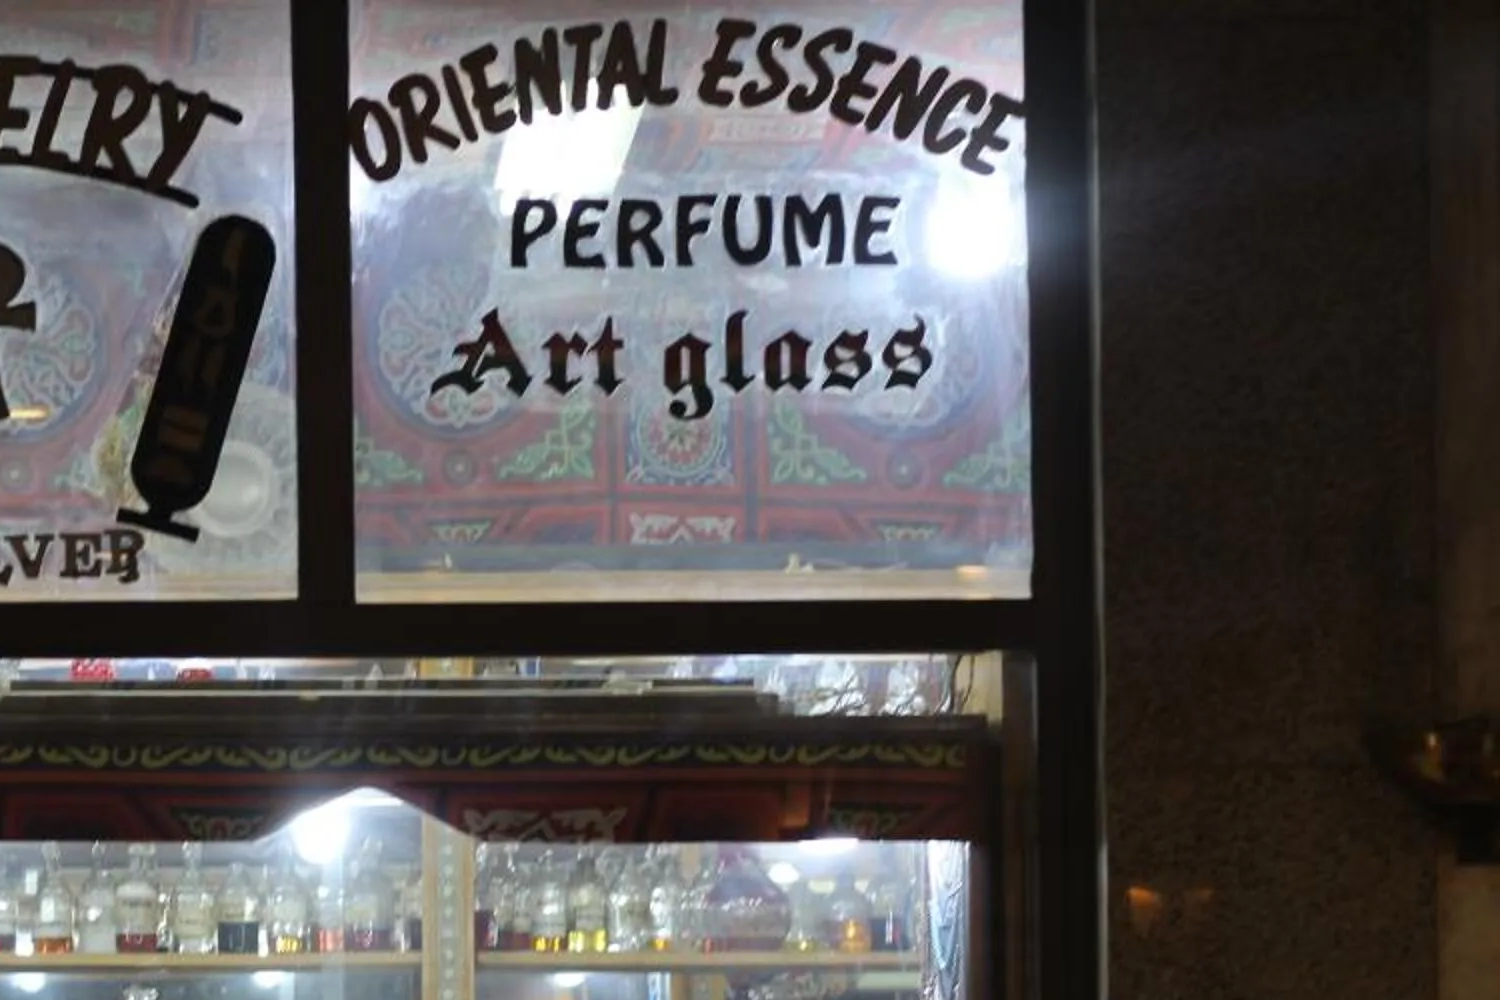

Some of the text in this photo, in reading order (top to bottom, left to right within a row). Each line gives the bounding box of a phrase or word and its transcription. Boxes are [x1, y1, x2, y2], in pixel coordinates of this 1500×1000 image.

[349, 19, 1026, 182] ORIENTAL ESSENCE
[509, 193, 901, 269] PERFUME
[431, 307, 934, 420] Art glass
